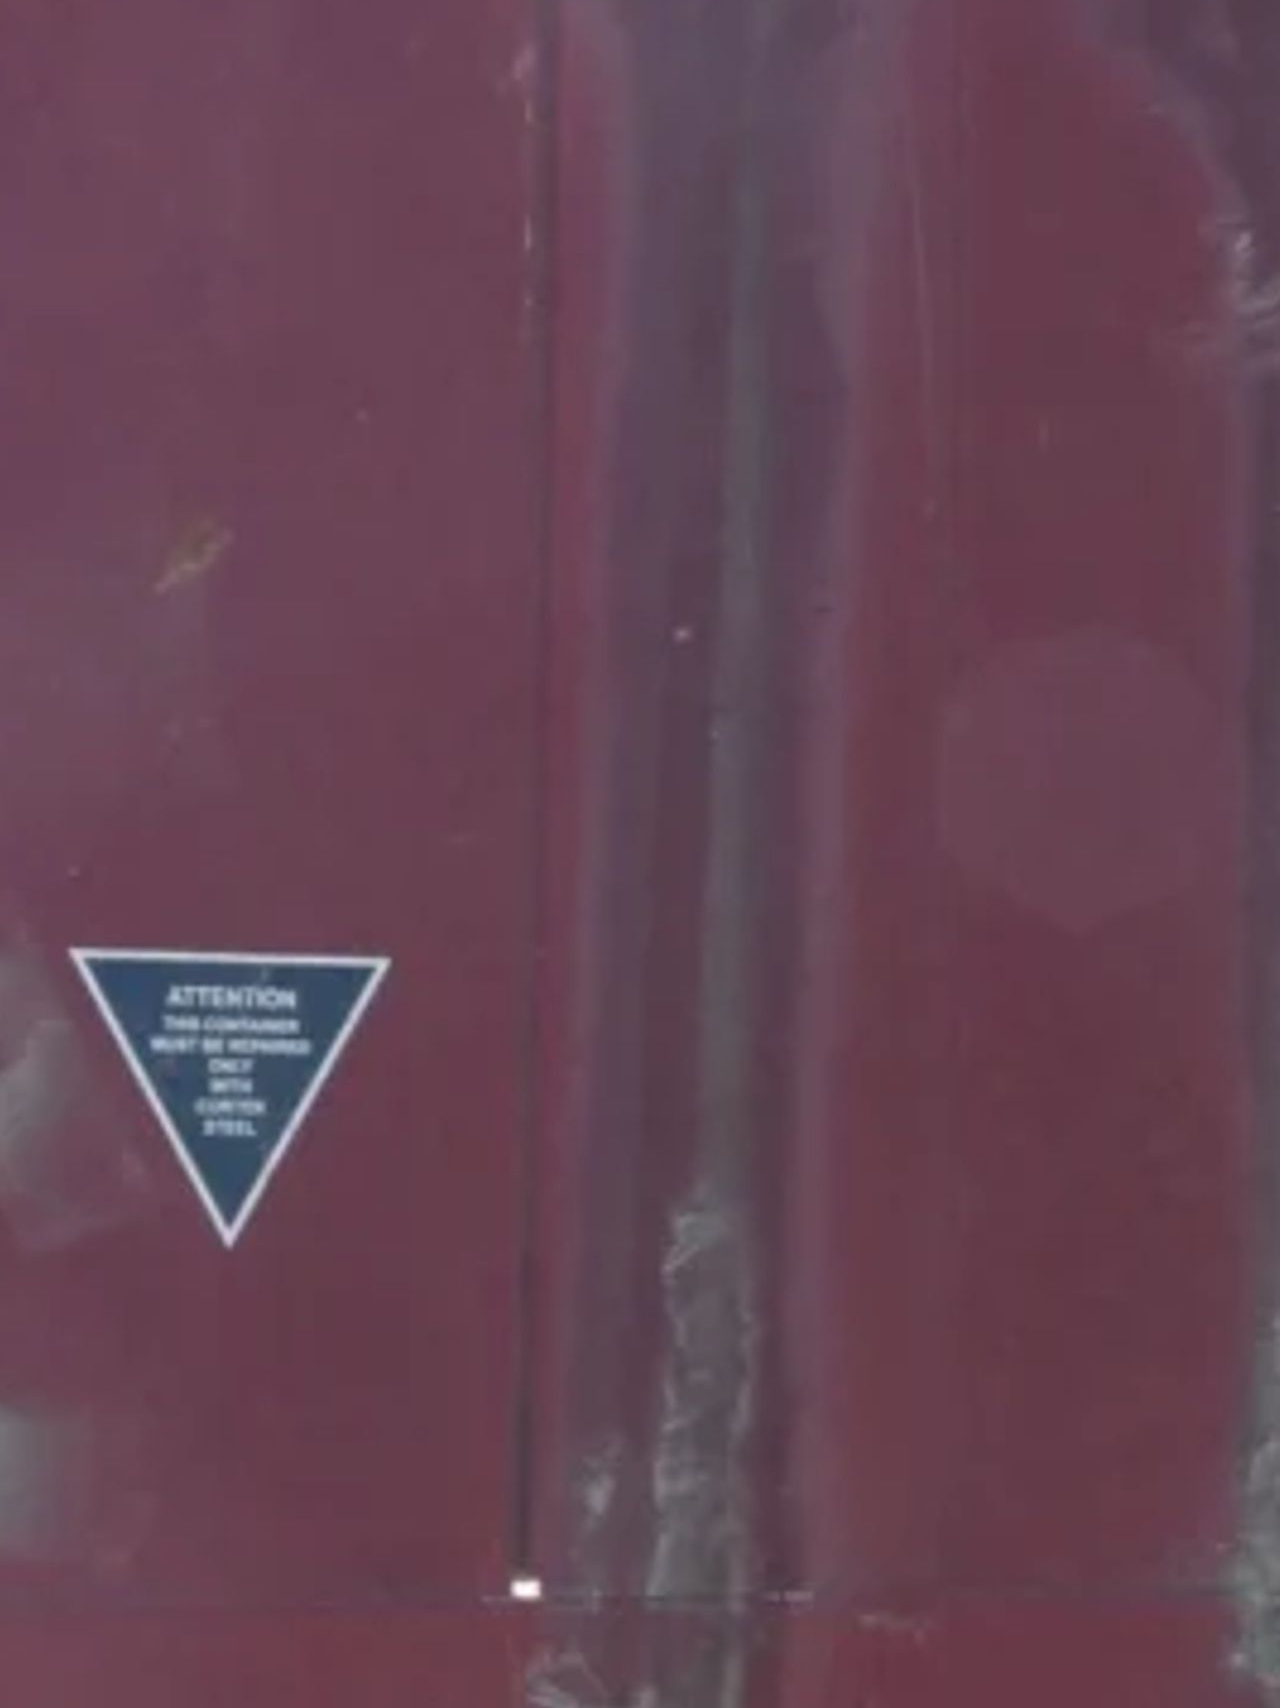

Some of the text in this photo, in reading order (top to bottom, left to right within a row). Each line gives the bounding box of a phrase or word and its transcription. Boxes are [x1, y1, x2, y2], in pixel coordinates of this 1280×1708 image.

[165, 985, 297, 1010] ATTENTION
[208, 1058, 255, 1074] ONLY
[202, 1119, 257, 1136] STEEL
